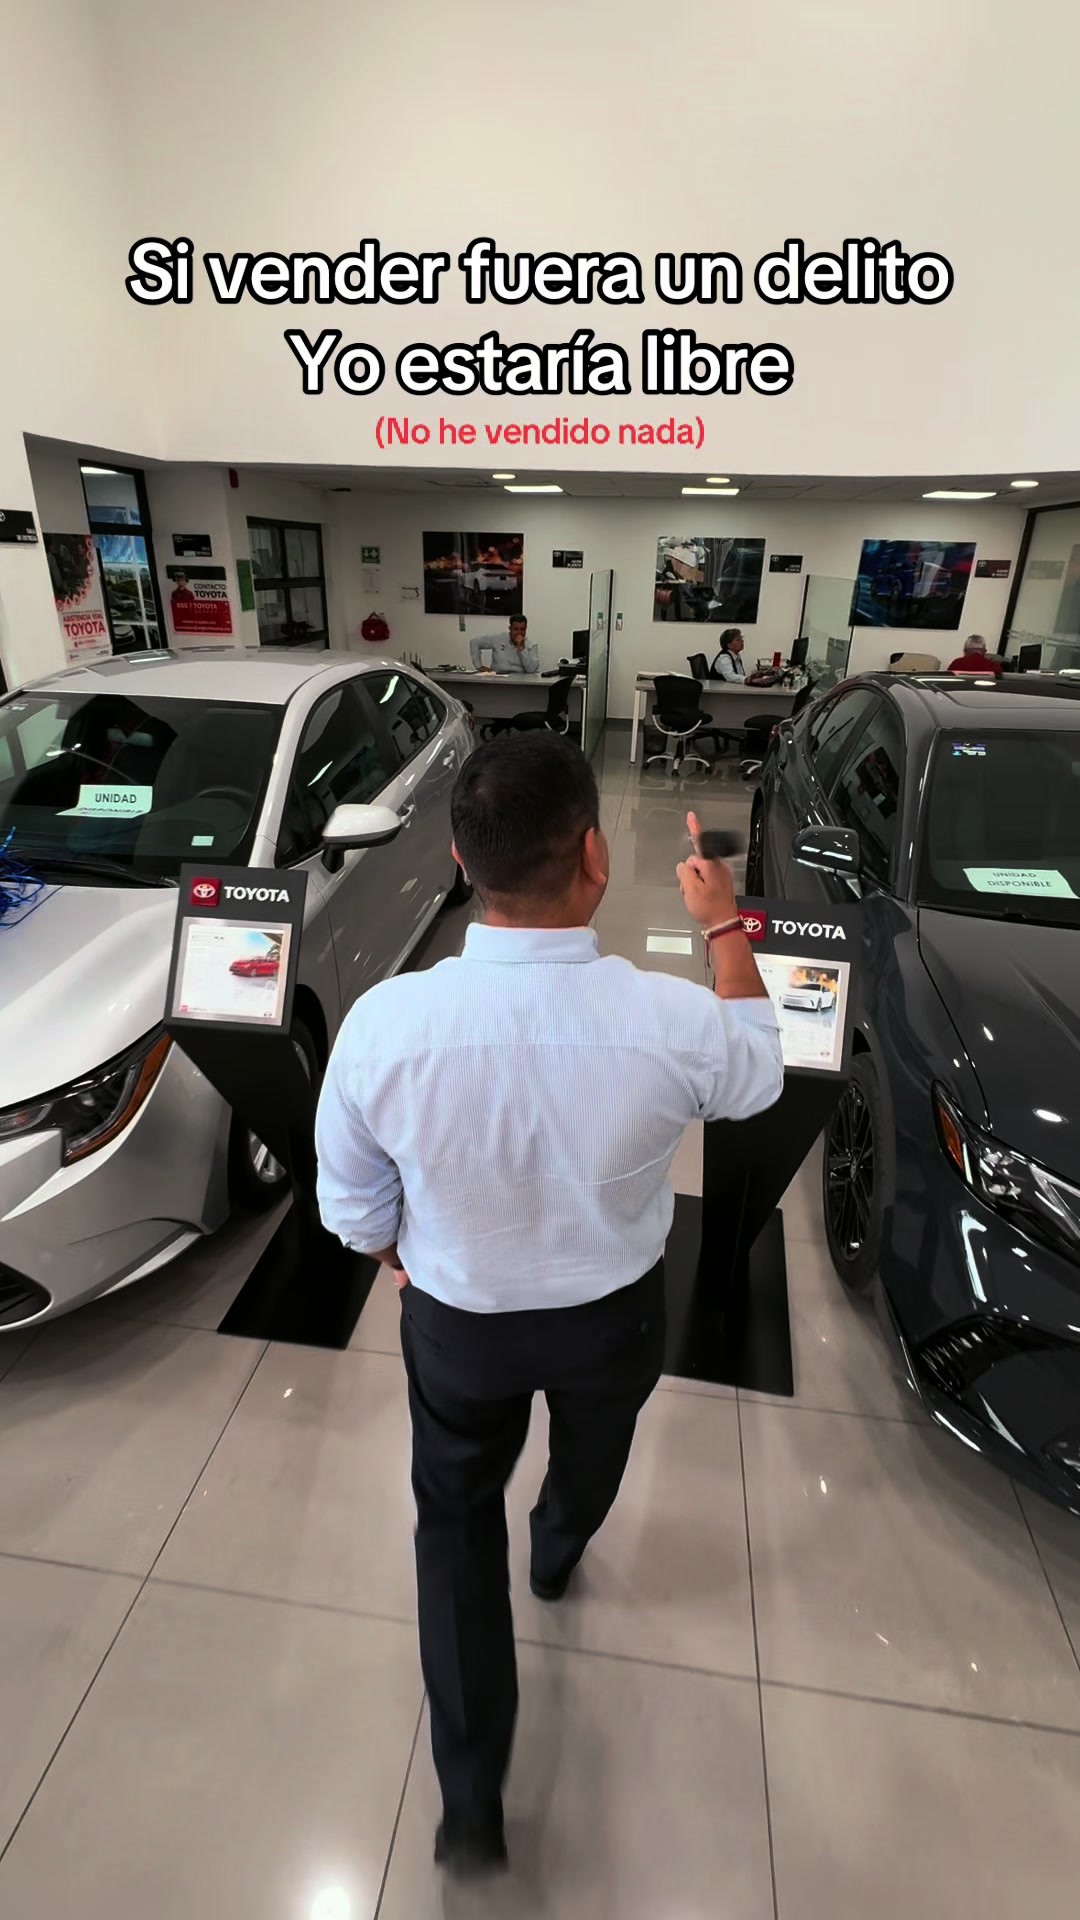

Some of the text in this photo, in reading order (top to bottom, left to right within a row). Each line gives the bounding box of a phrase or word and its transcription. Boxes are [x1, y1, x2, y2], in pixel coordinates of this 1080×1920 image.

[64, 621, 106, 637] TOYOTA
[95, 793, 137, 804] UNIDAD
[987, 880, 1053, 888] DISPONIBLE
[224, 886, 290, 903] TOYOTA
[771, 919, 847, 940] TOYOTA
